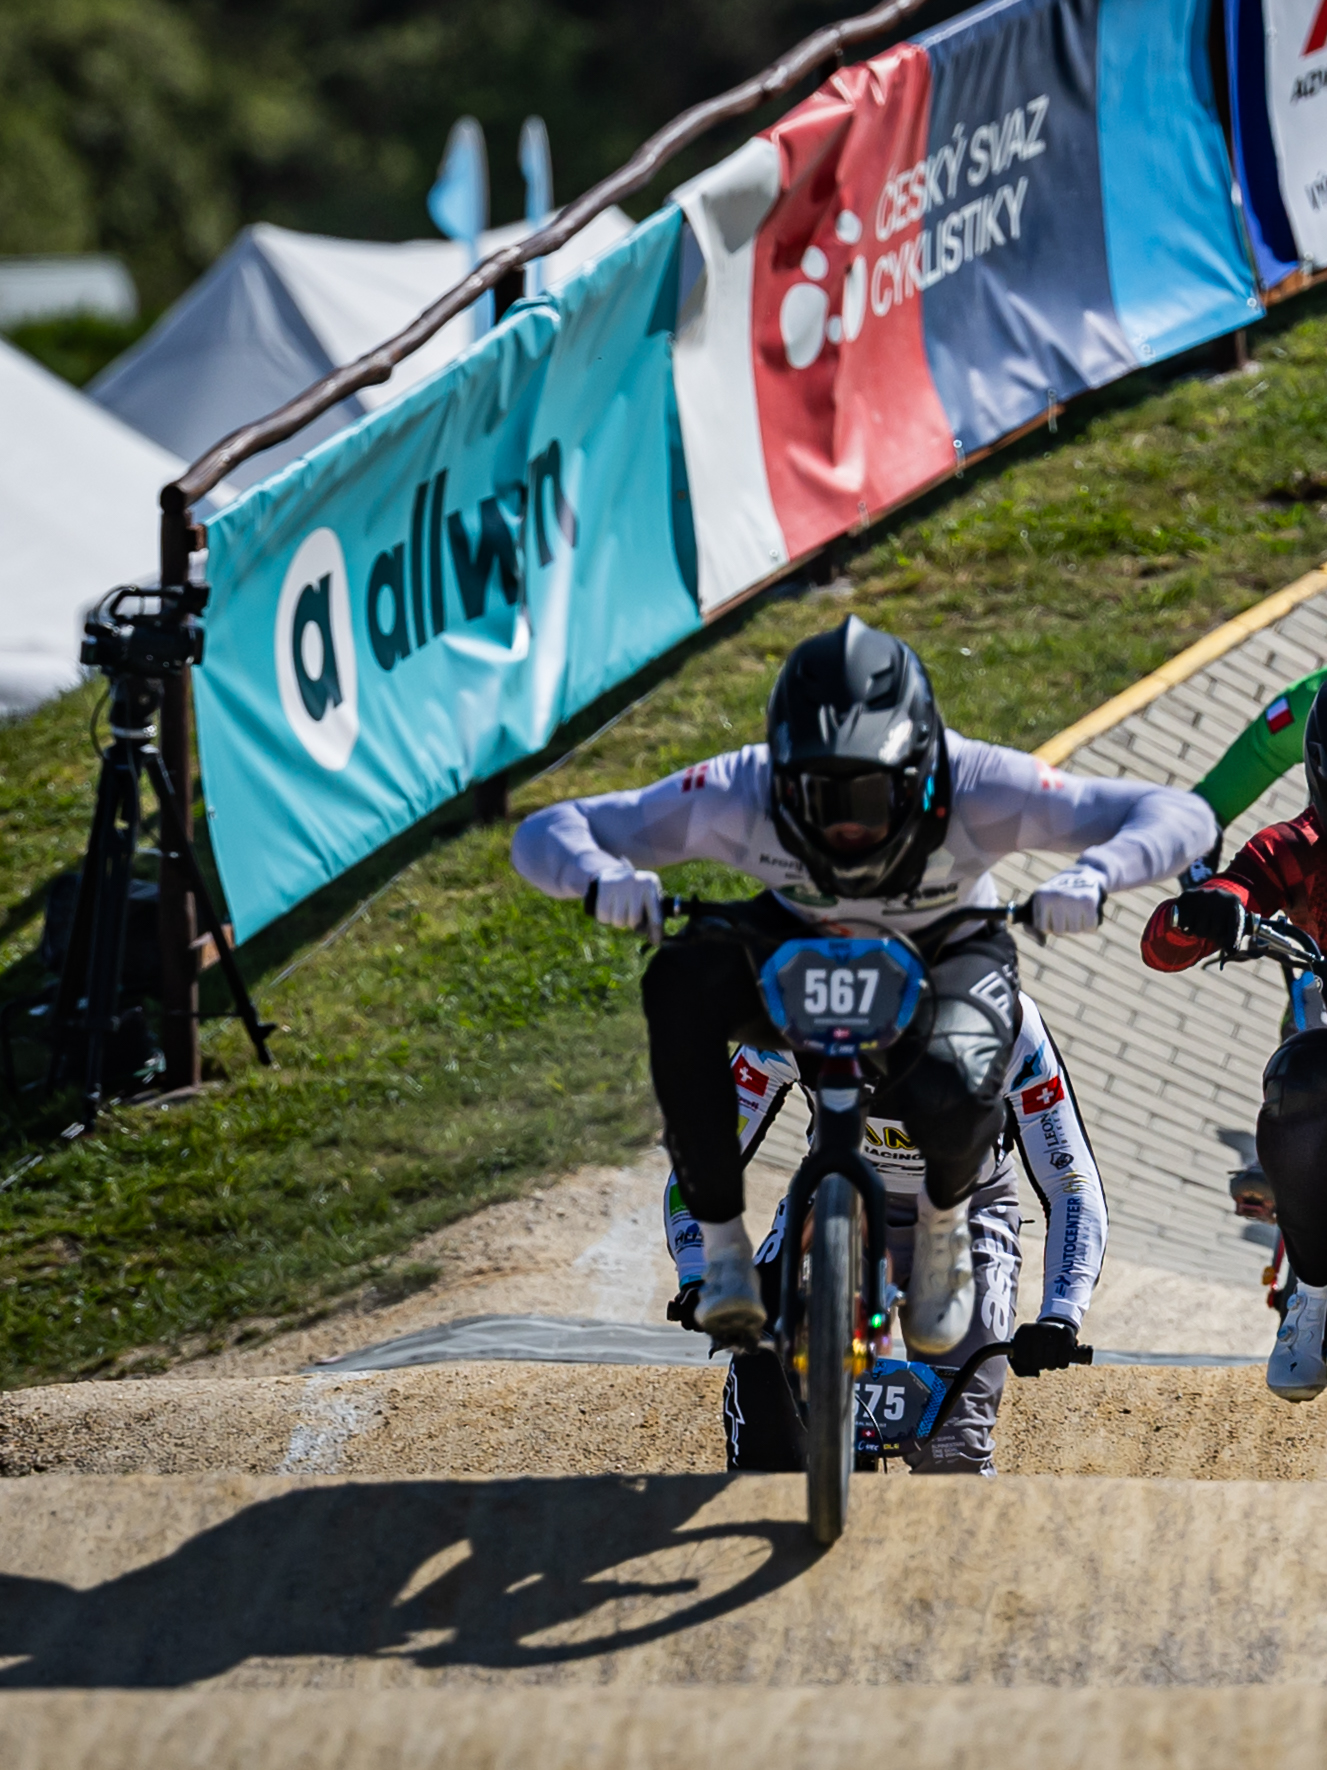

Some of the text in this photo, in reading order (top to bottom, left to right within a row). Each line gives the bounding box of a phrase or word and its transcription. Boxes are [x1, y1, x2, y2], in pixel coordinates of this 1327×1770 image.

[966, 93, 1050, 187] SVAZ
[871, 176, 1029, 317] CYKLISTIKY
[803, 968, 880, 1015] 567
[1040, 1113, 1059, 1148] LEON
[1061, 1197, 1081, 1277] AUTOCENTER
